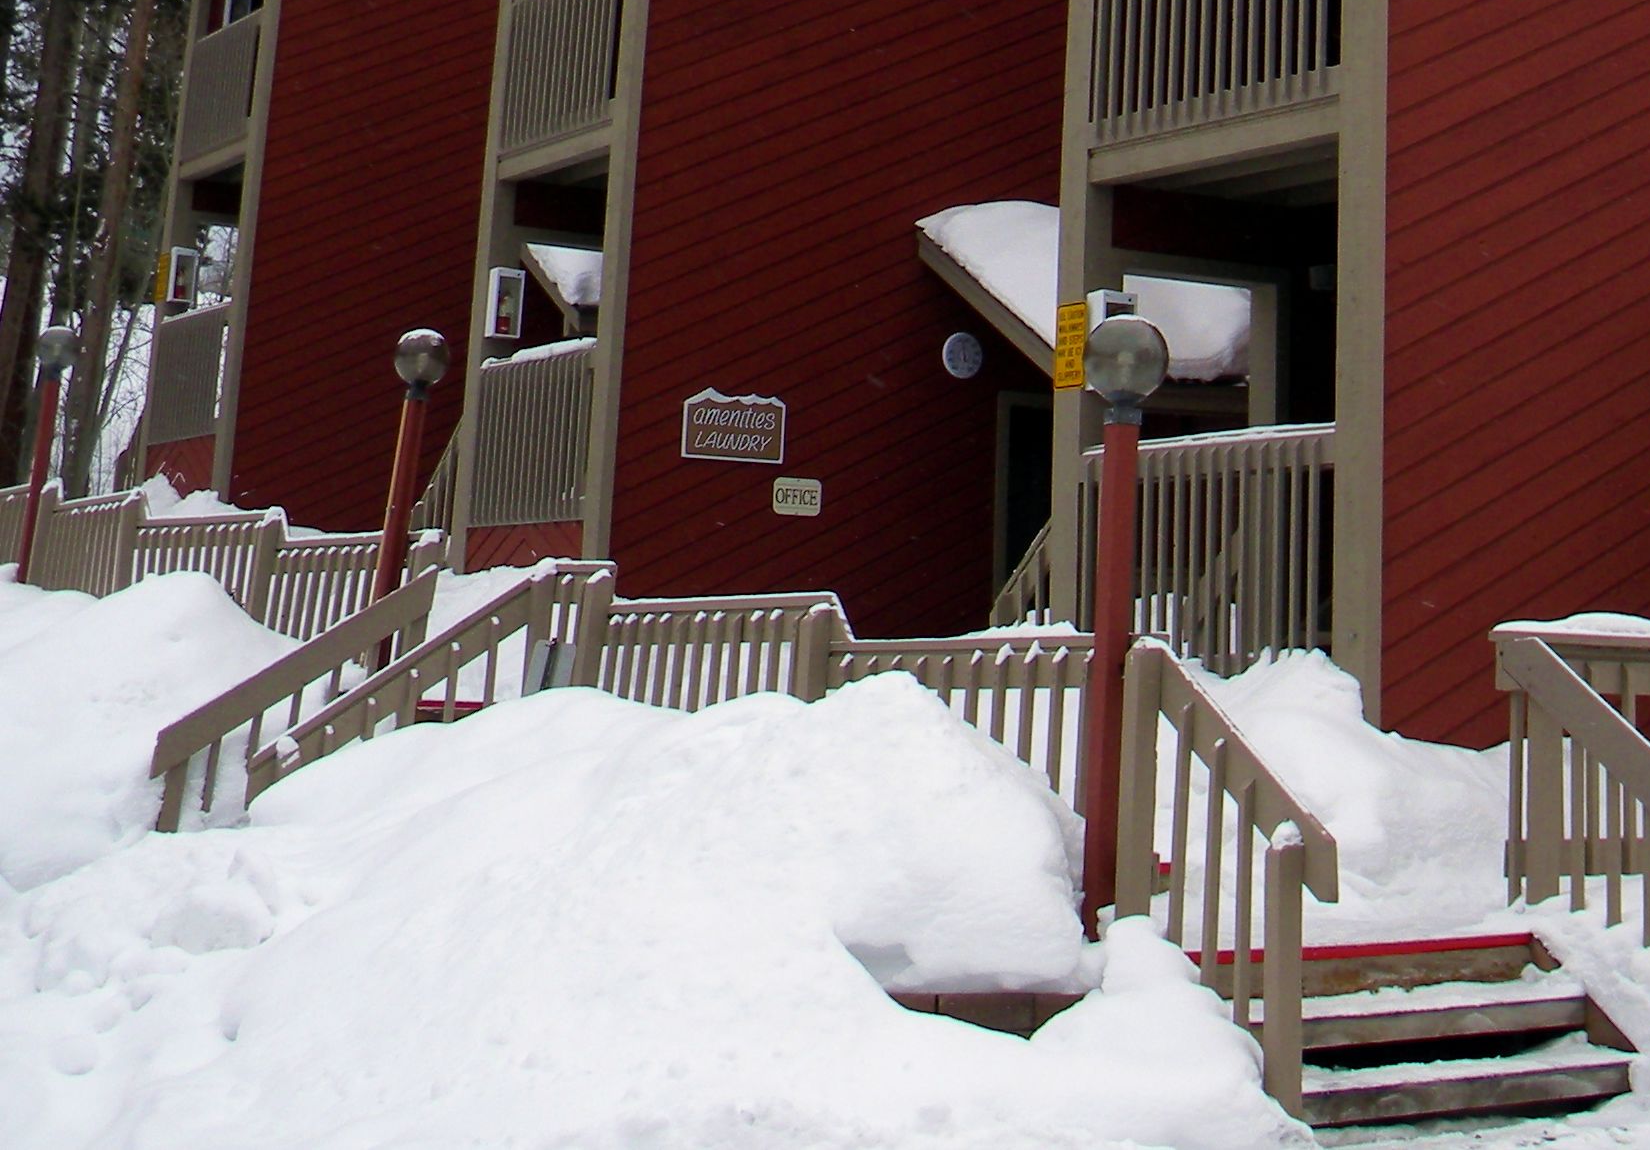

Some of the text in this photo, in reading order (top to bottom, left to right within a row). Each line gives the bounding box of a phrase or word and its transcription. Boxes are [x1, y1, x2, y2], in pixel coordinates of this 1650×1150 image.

[693, 407, 776, 430] amenities
[694, 431, 773, 451] LAUNDRY
[775, 487, 818, 506] OFFICE
